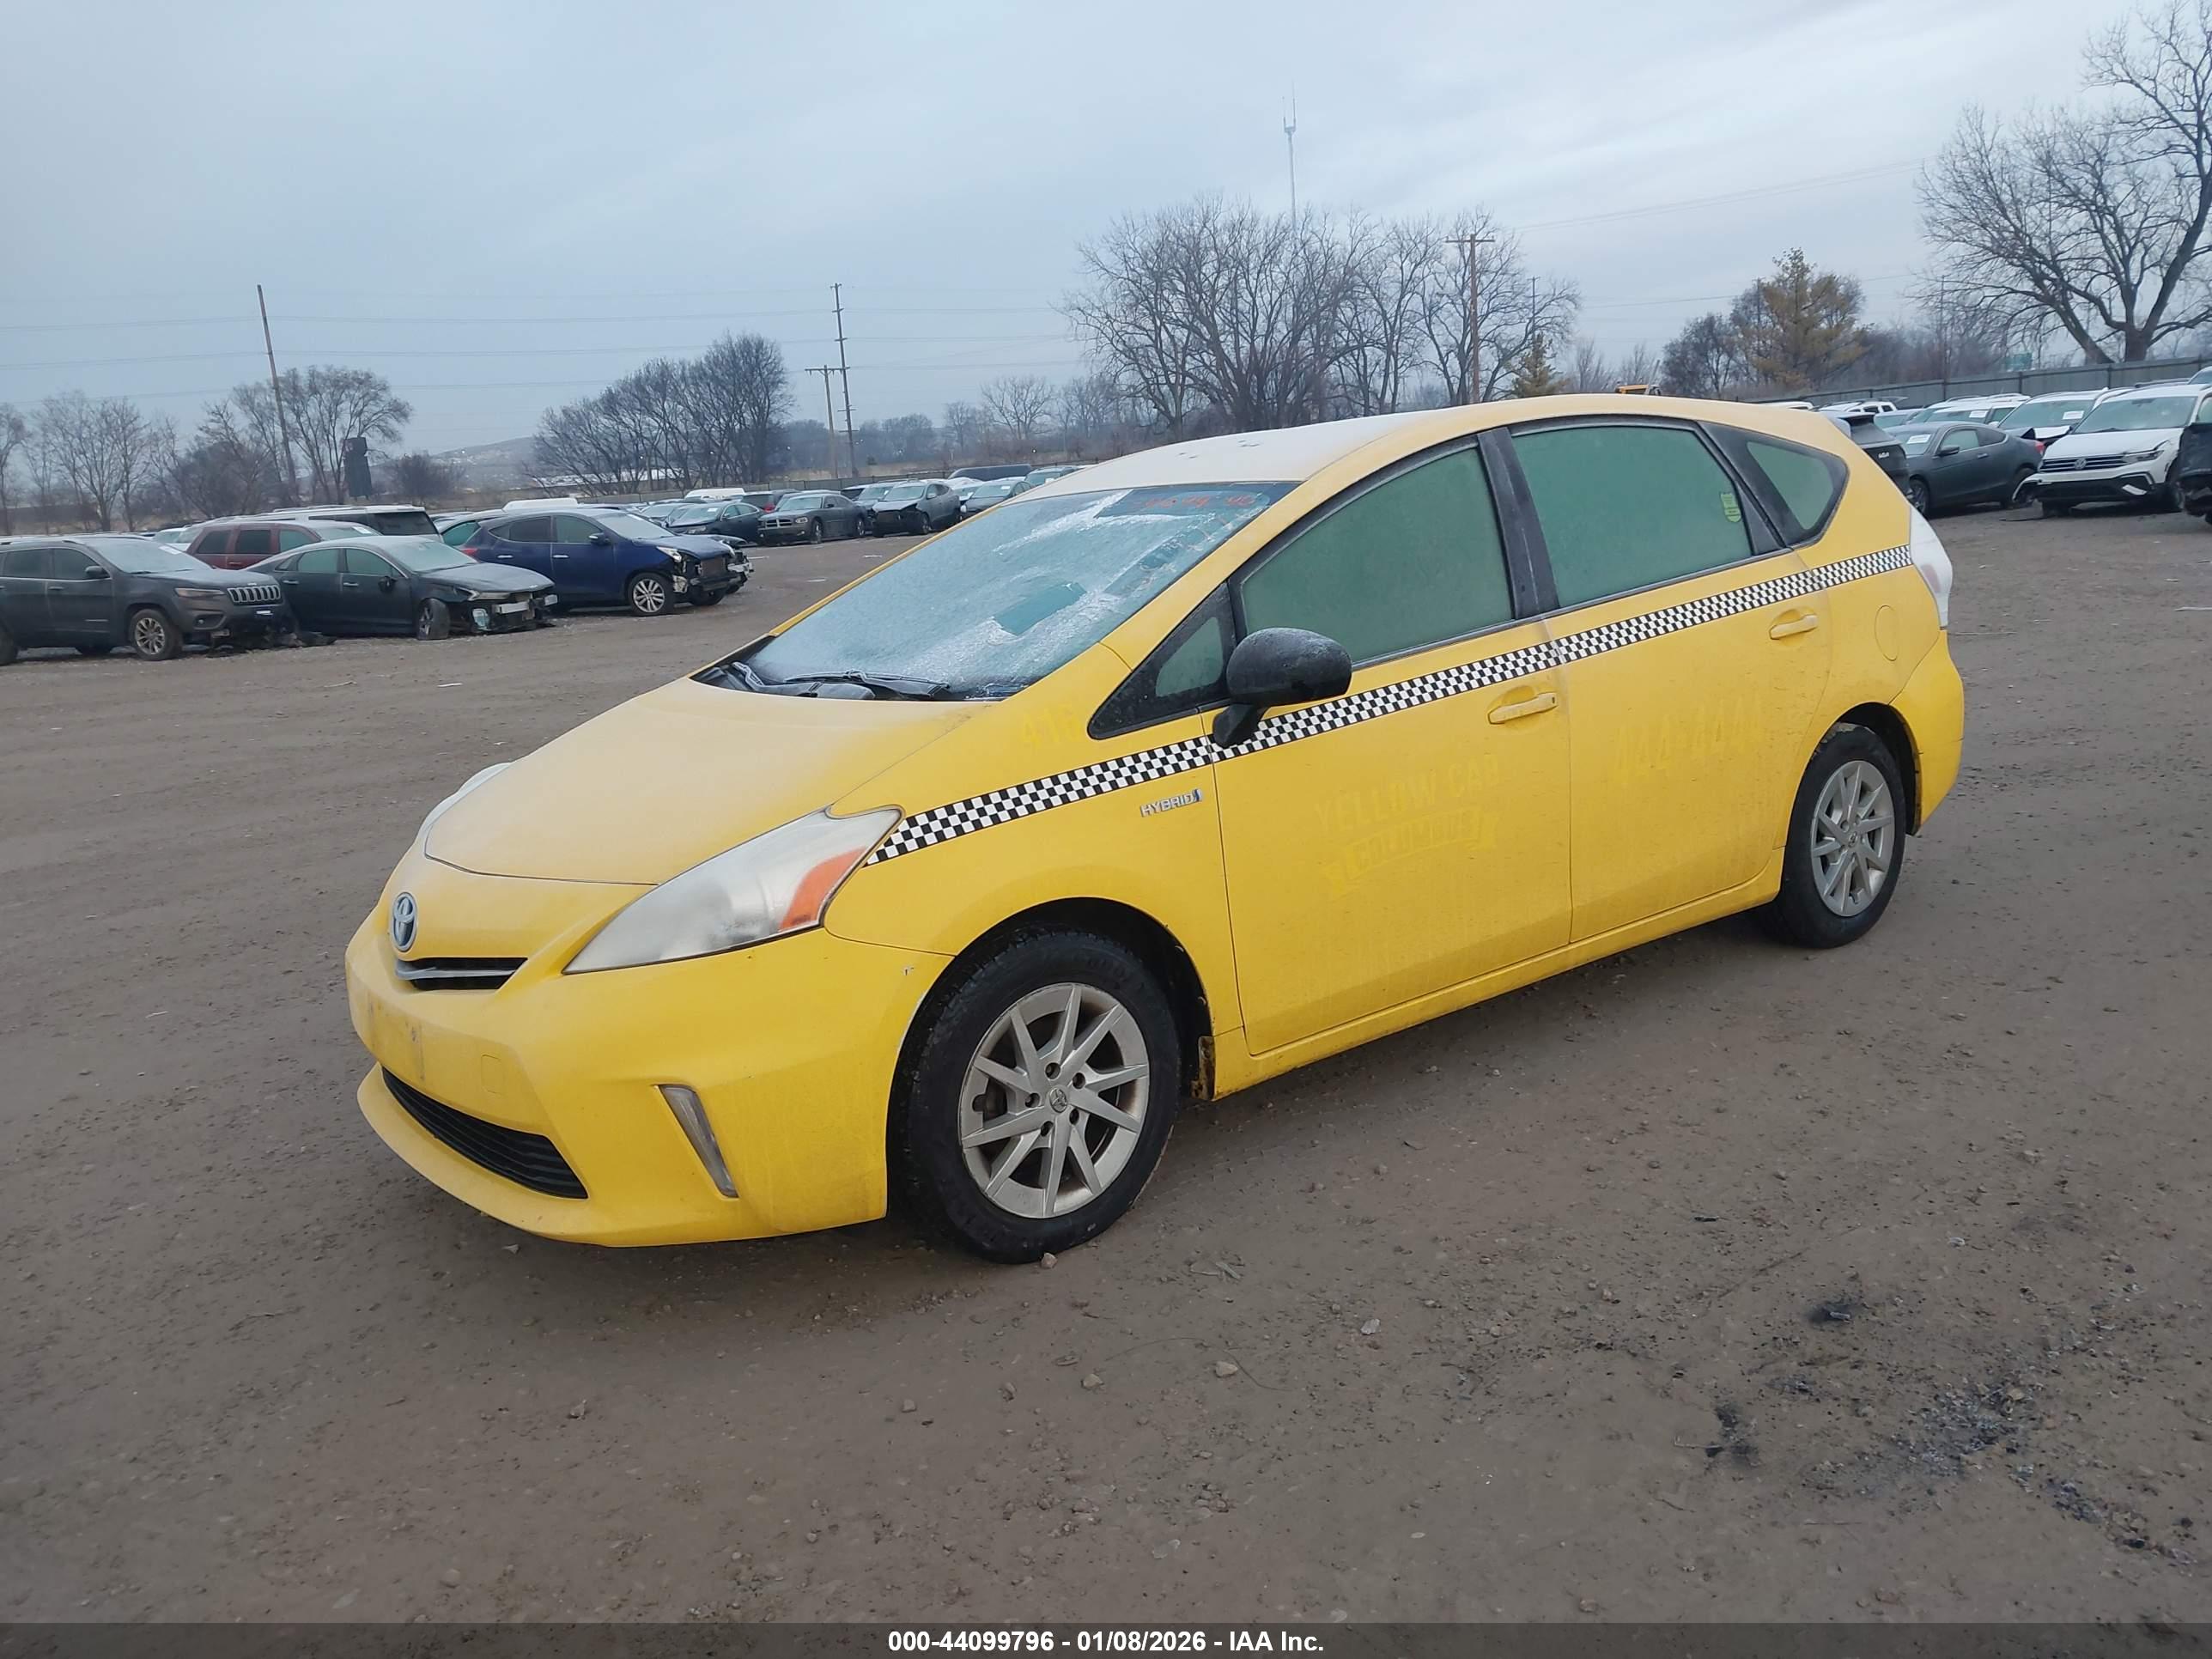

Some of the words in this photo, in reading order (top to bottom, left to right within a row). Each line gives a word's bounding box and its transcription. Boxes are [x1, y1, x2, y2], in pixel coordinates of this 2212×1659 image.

[1139, 793, 1194, 817] HYBRID
[1313, 771, 1439, 835] YELLOW
[1447, 753, 1501, 799] CAB
